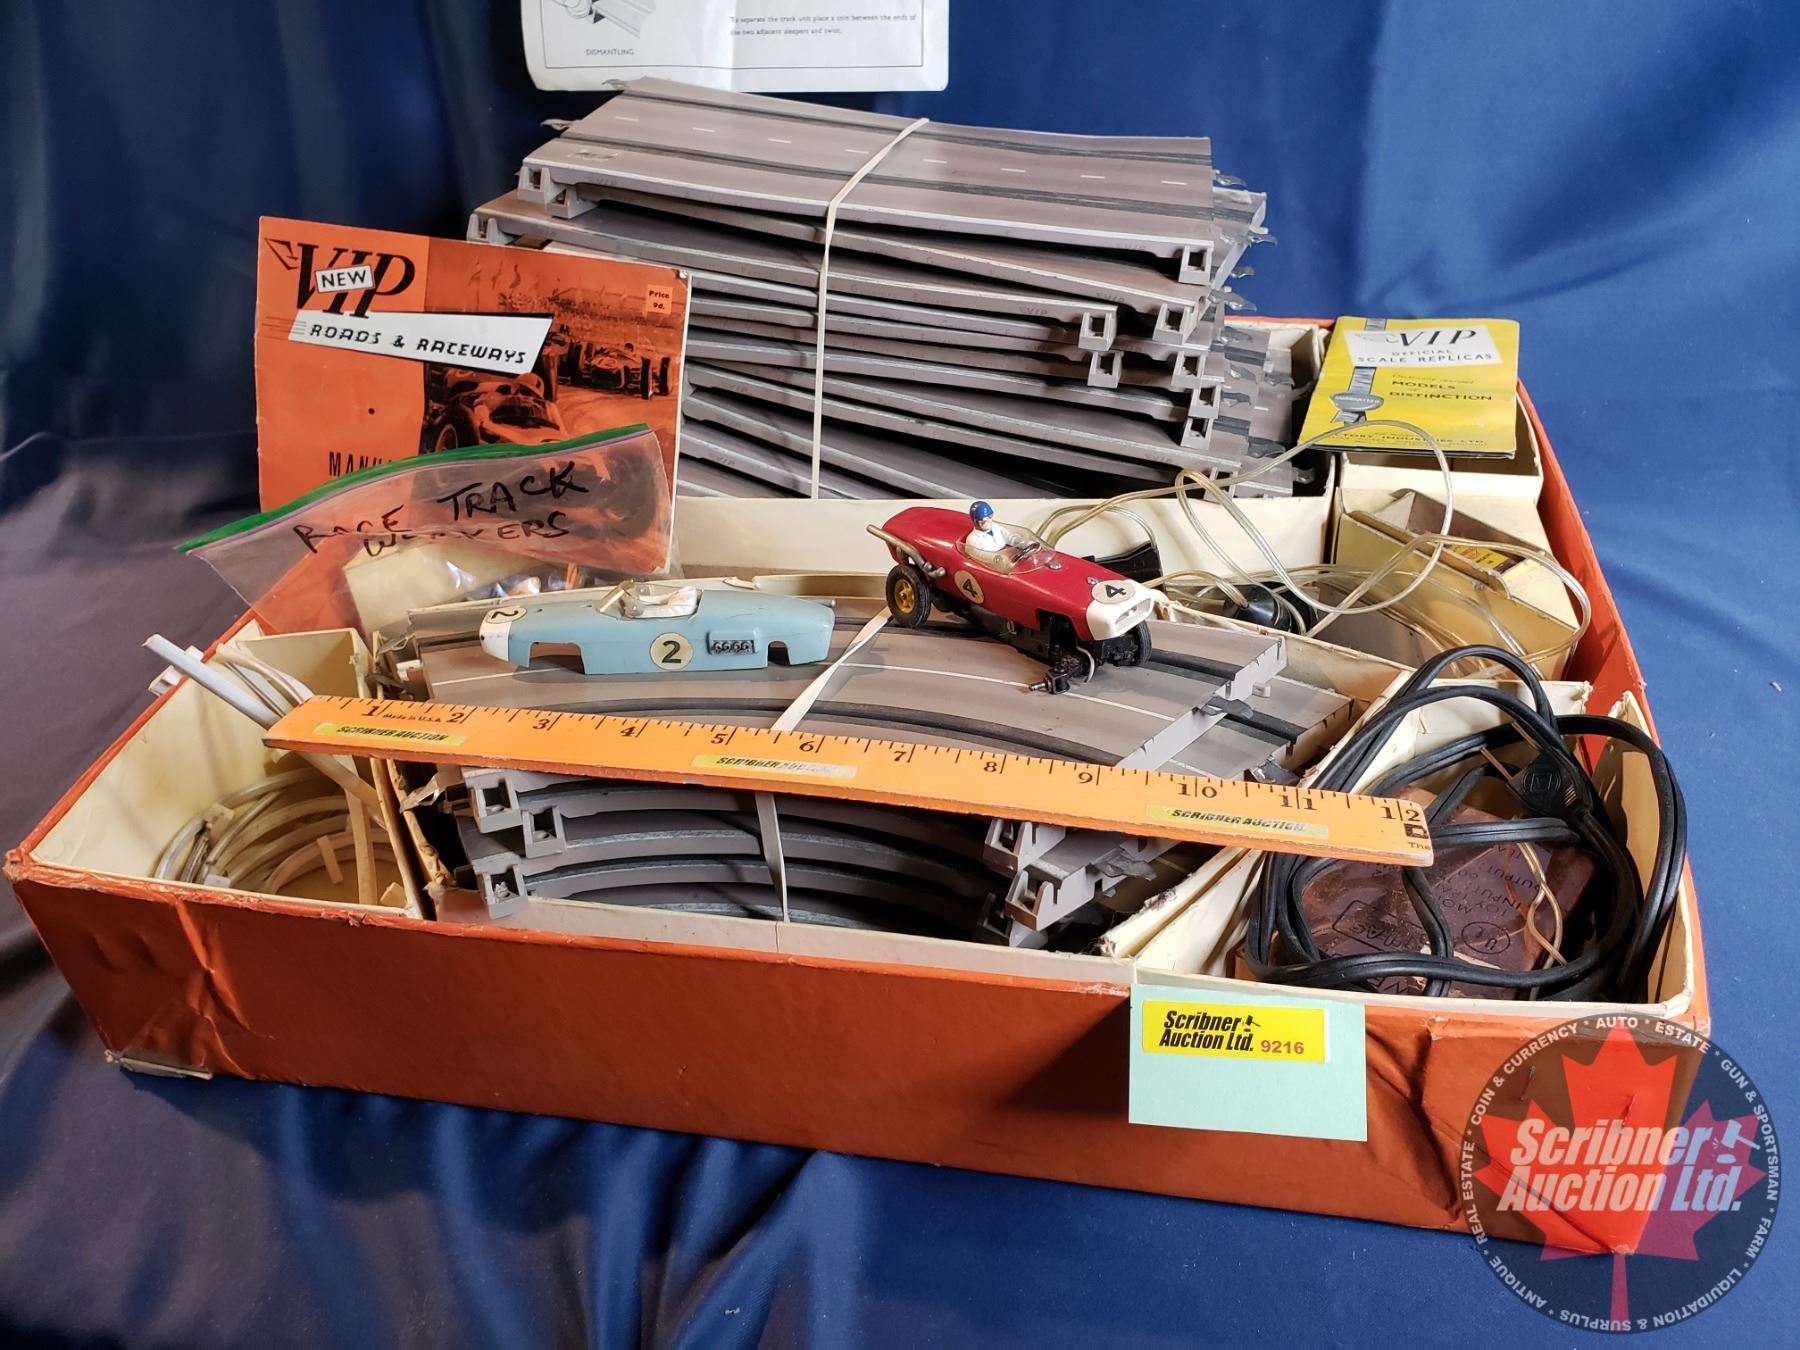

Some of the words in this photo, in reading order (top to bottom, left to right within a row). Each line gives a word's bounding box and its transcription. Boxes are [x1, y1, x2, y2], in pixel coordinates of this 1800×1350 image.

[812, 16, 829, 24] place
[585, 48, 635, 57] DISMANTLING
[320, 268, 368, 289] NEW
[648, 290, 670, 299] Price
[308, 323, 384, 346] ROADS
[392, 334, 406, 349] &
[415, 337, 527, 365] RACEWAYS
[1400, 329, 1477, 347] VIP
[1418, 353, 1492, 363] REPLICAS
[1392, 381, 1456, 390] MODELS
[1389, 391, 1492, 401] DISTINCTION
[436, 461, 590, 521] TRACK
[963, 579, 977, 597] 4
[1105, 584, 1127, 598] 4
[661, 640, 682, 664] 2
[362, 706, 379, 716] 1
[446, 712, 465, 723] 2
[533, 718, 548, 731] 3
[620, 726, 637, 738] 4
[711, 733, 728, 745] 5
[800, 741, 815, 753] 6
[894, 751, 907, 763] 7
[983, 761, 998, 774] 8
[1078, 772, 1094, 784] 9
[396, 730, 448, 743] AUCTION
[1243, 816, 1305, 833] AUCTION
[1407, 841, 1431, 850] The
[1164, 1010, 1242, 1032] Scribner
[1159, 1028, 1225, 1050] Auction
[1226, 1033, 1254, 1051] Ltd.
[1260, 1040, 1304, 1054] 9216
